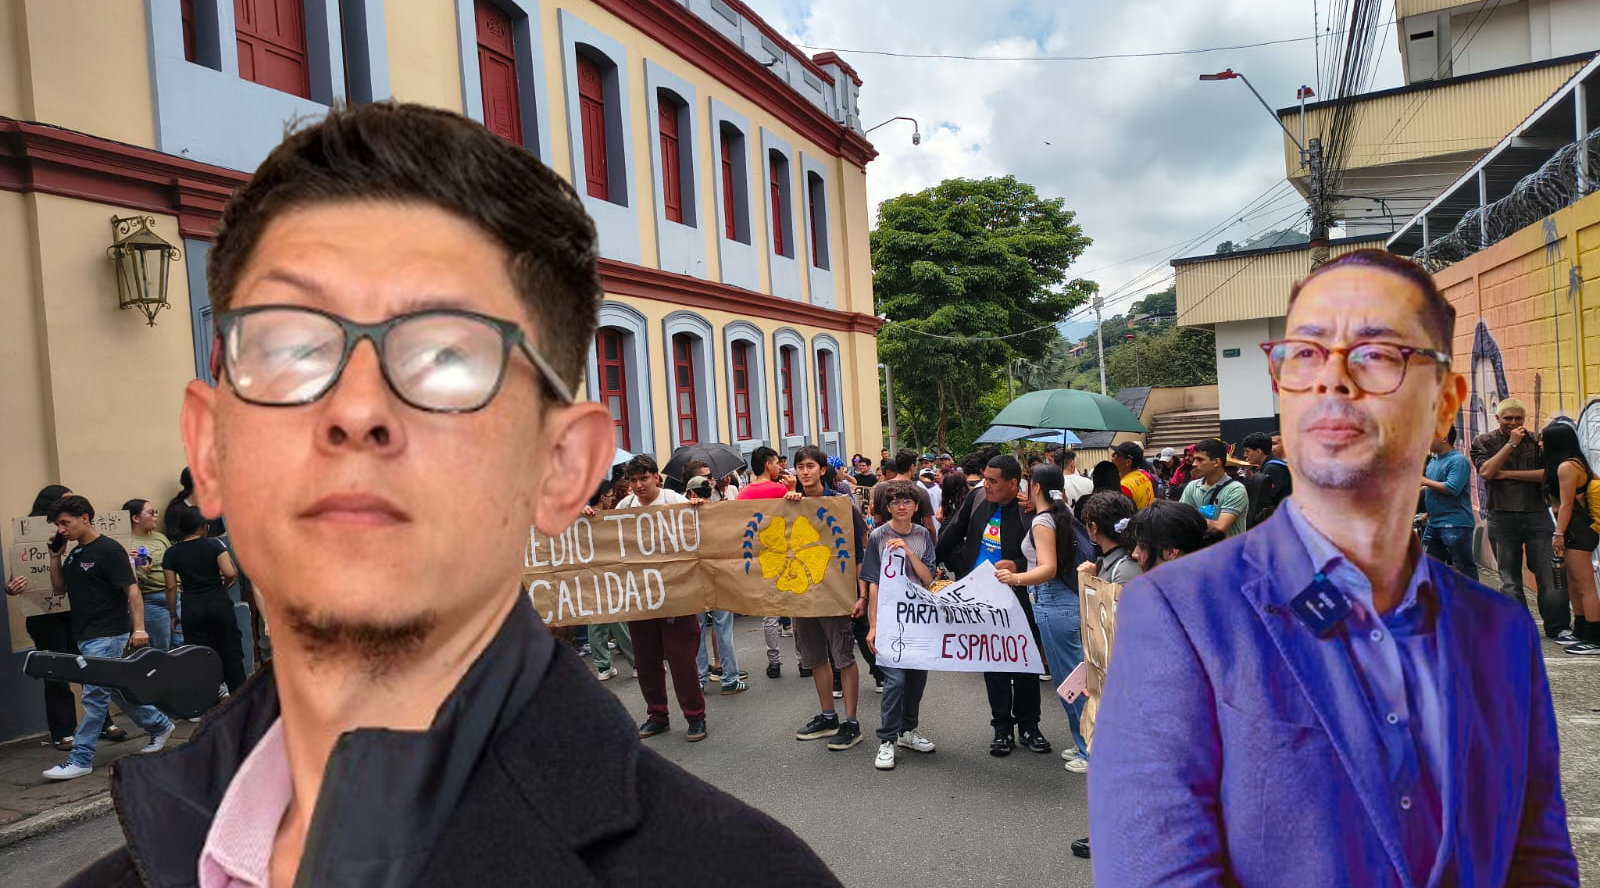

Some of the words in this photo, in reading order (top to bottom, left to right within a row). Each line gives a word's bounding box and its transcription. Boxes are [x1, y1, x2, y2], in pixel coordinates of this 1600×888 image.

[525, 517, 594, 567] EDIO
[529, 568, 666, 624] CALIDAD
[897, 602, 938, 624] PARA
[988, 608, 1010, 628] MI
[941, 633, 1028, 667] ESPACIO?
